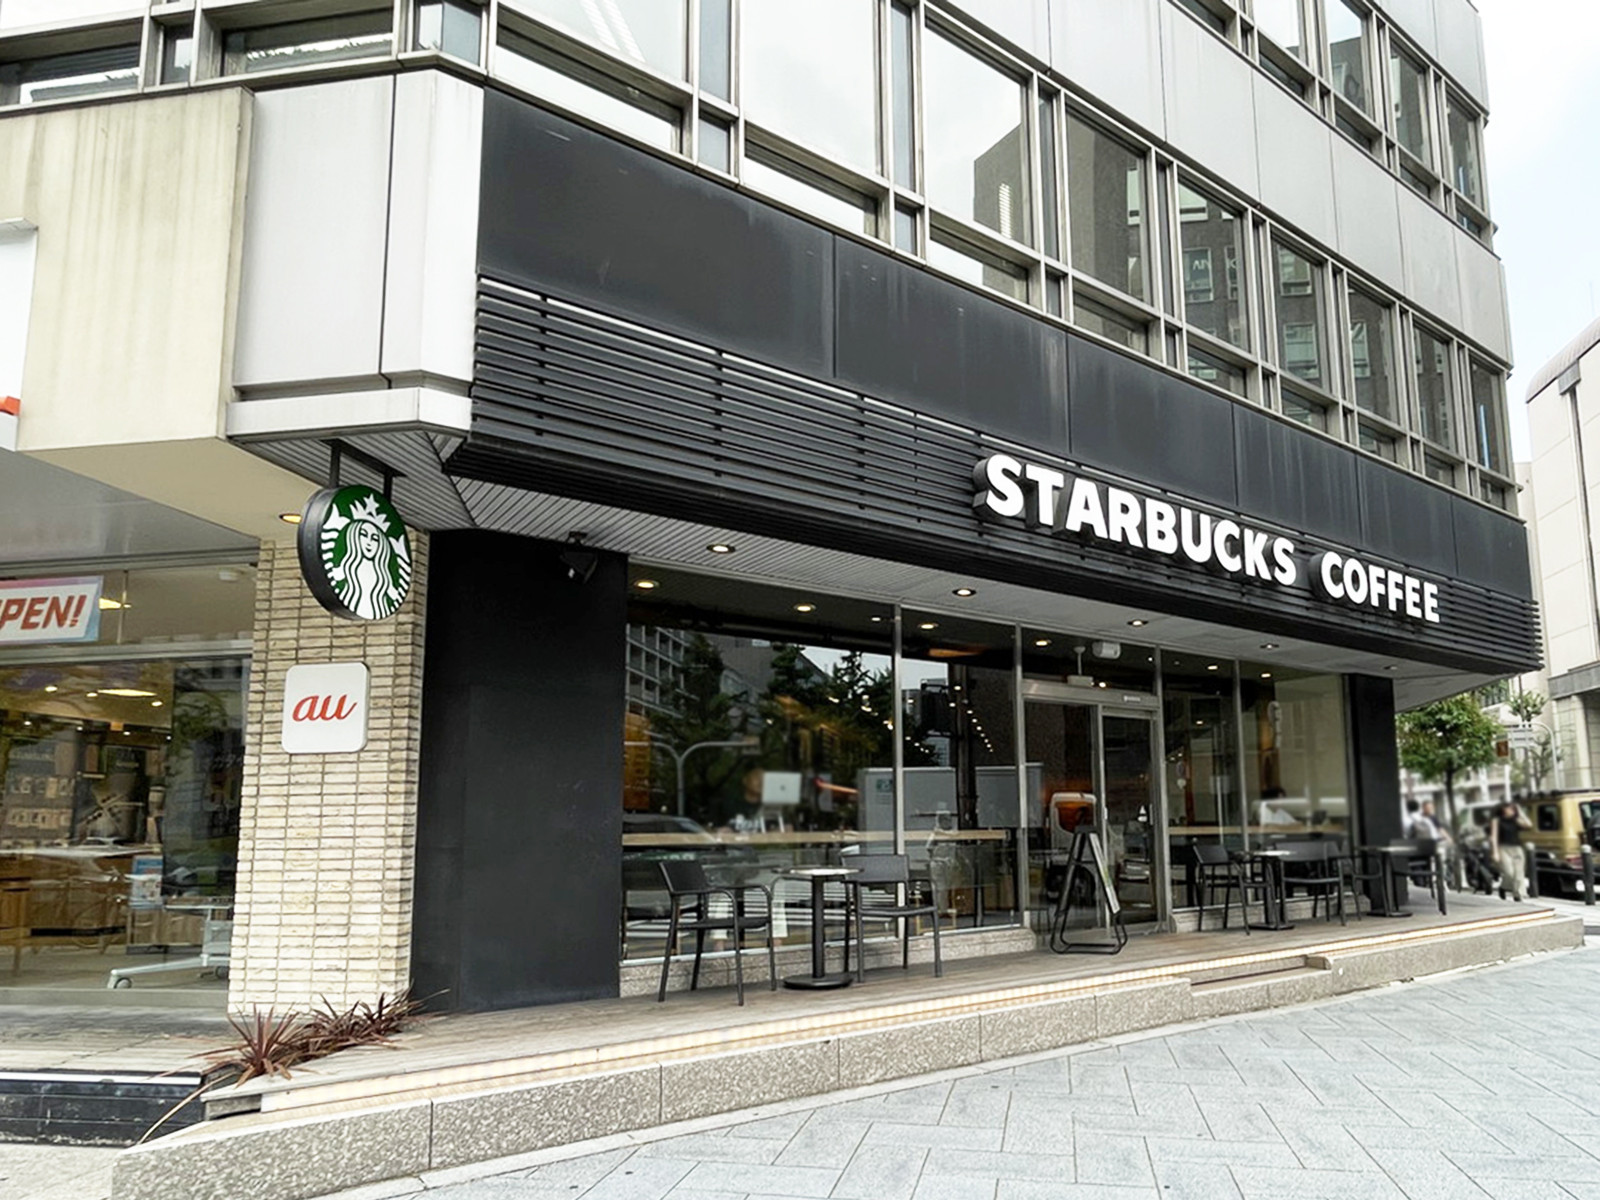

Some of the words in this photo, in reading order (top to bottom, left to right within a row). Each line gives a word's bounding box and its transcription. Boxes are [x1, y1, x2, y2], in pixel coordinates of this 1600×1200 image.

[982, 453, 1298, 587] STARBUCKS
[1319, 550, 1441, 624] COFFEE
[0, 594, 87, 630] PEN!
[292, 693, 359, 722] au
